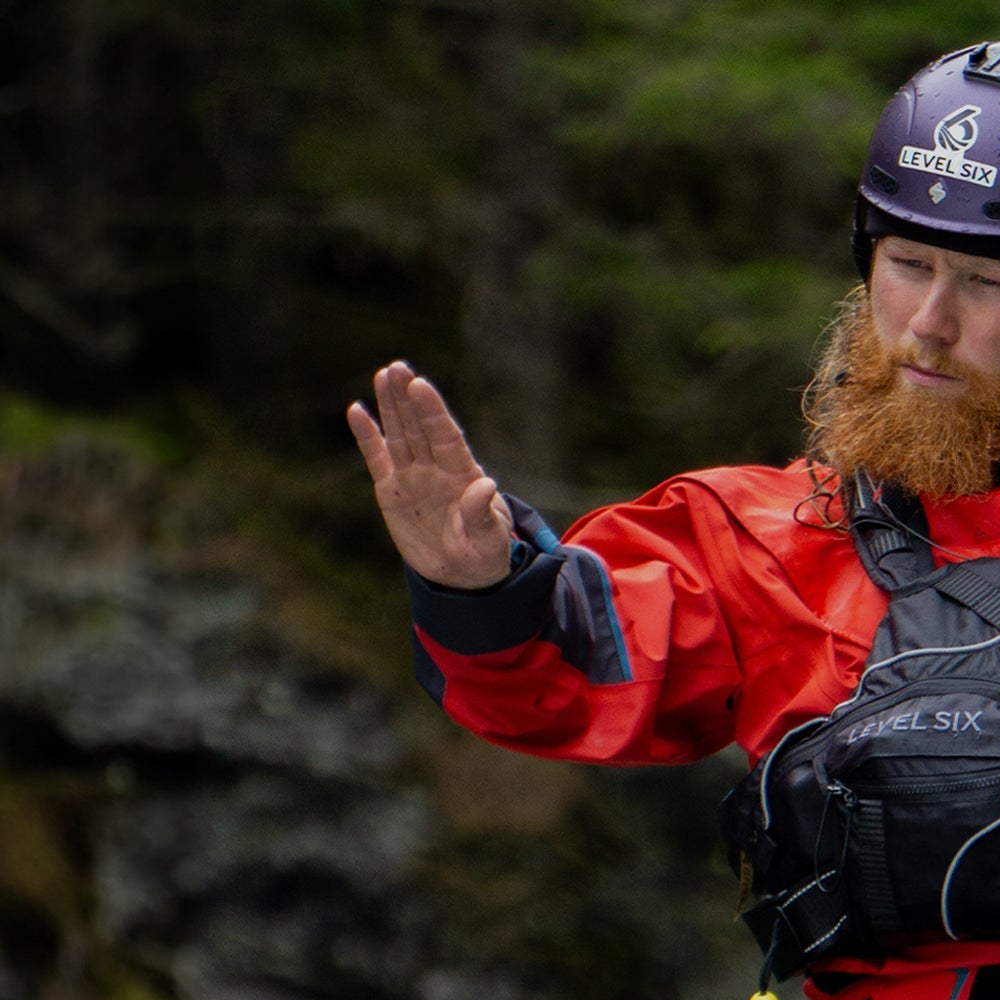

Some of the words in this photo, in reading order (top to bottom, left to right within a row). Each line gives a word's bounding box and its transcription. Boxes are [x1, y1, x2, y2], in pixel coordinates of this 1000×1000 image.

[901, 150, 955, 175] LEVEL
[959, 163, 993, 184] SIX
[847, 711, 928, 745] LEVEL
[933, 711, 983, 733] SIX
